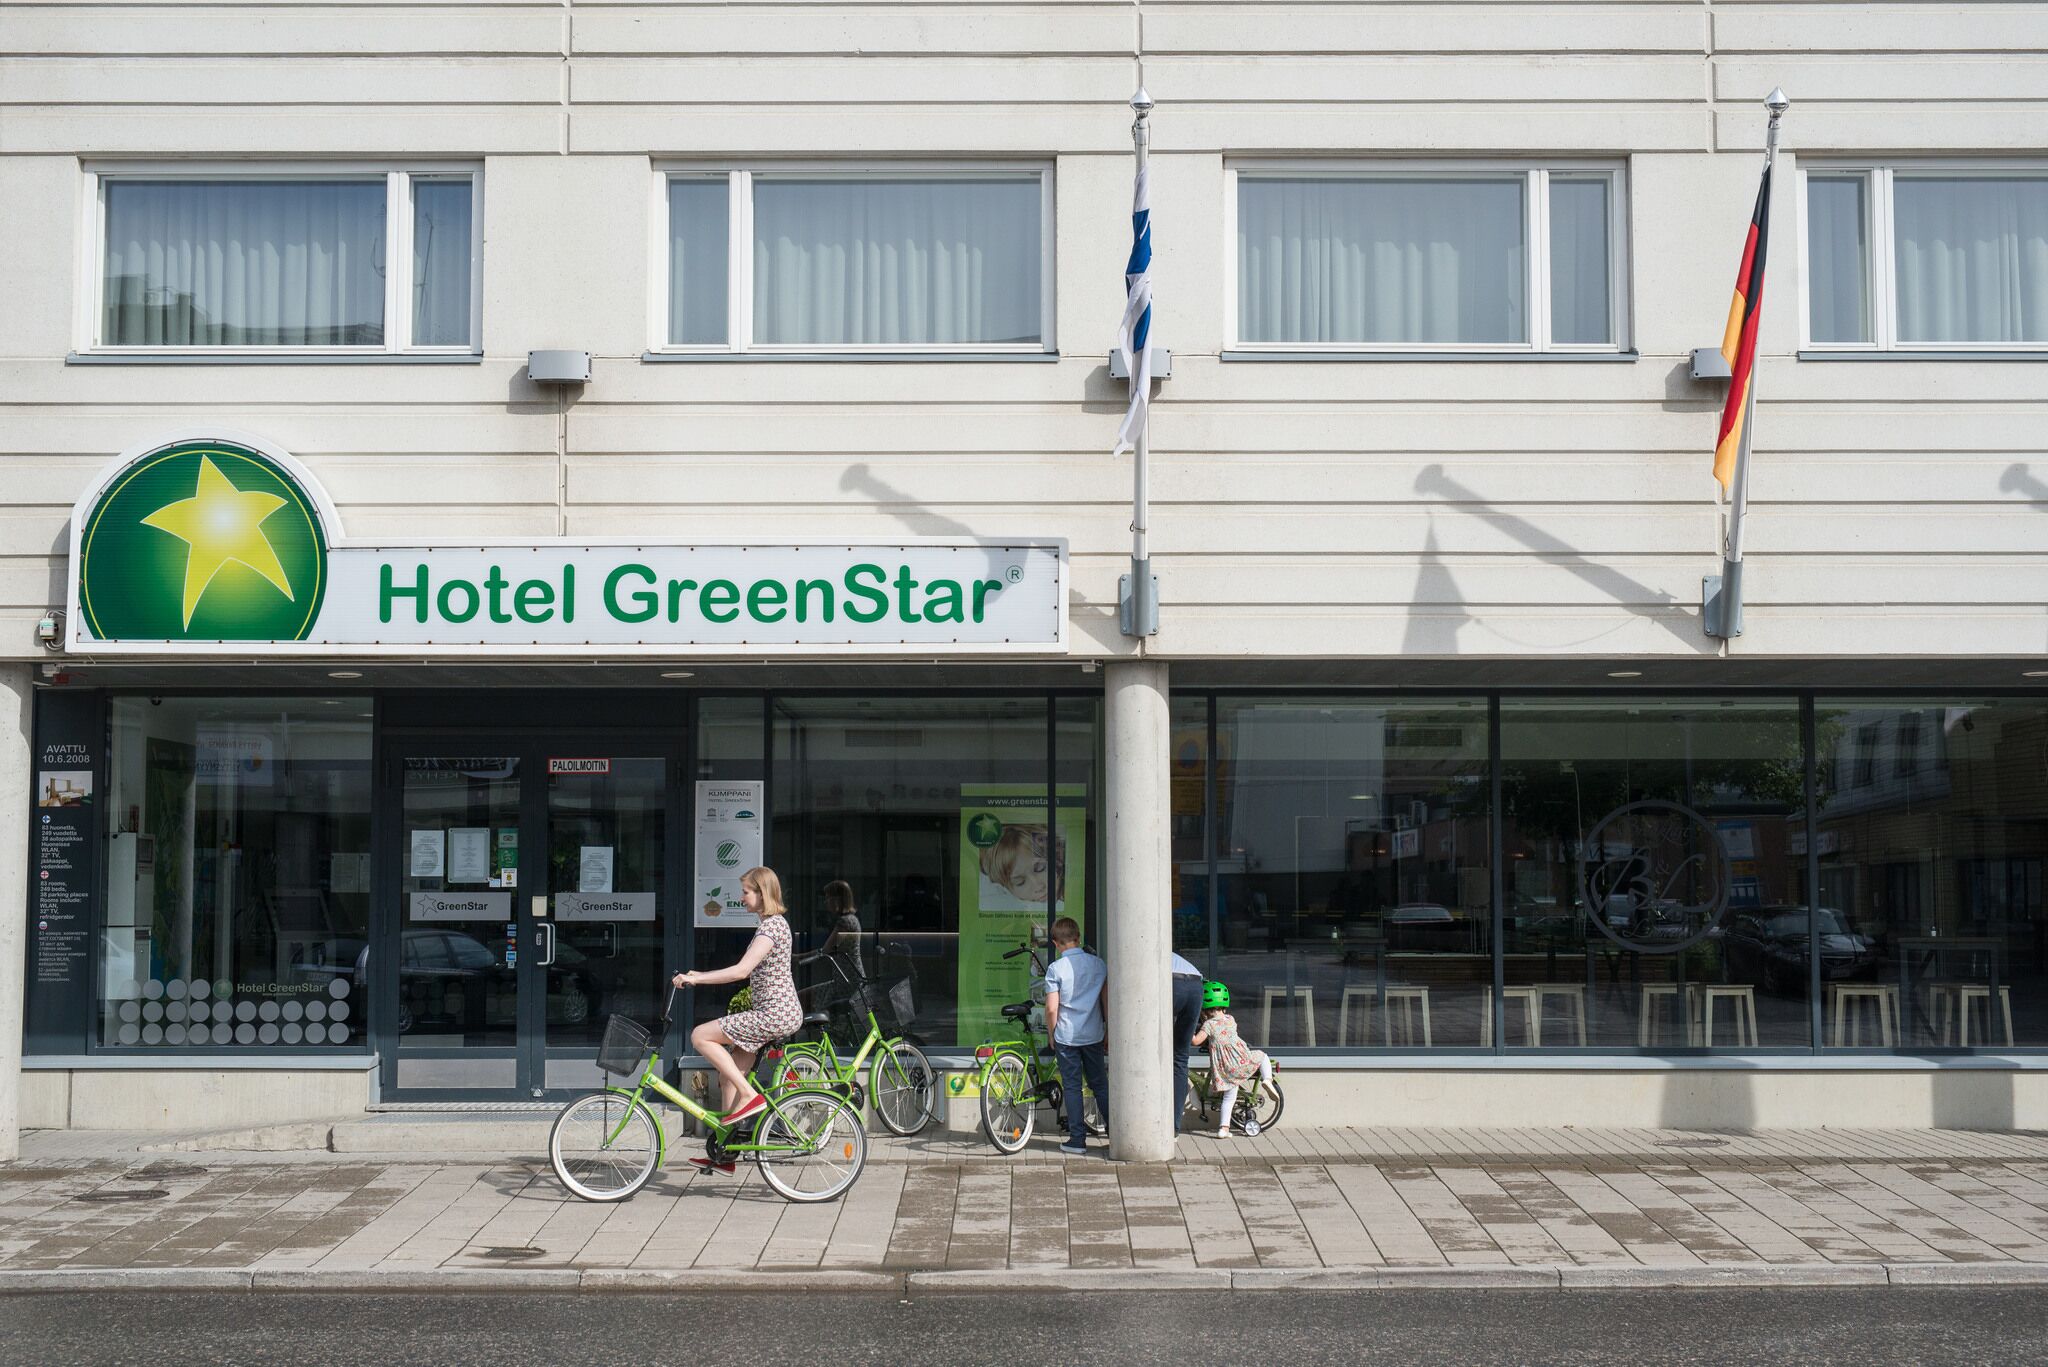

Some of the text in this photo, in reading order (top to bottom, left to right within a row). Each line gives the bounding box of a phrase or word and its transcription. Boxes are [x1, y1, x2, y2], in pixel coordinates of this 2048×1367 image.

[379, 563, 575, 624] Hotel
[46, 744, 87, 753] AVATTU
[43, 754, 90, 763] 10.6.2008
[552, 760, 607, 771] PALOILMOITIN
[987, 796, 1060, 806] www.greenstai
[436, 901, 489, 911] GreenStar
[581, 901, 633, 911] GreenStar
[237, 983, 323, 993] Hotel GreenStar
